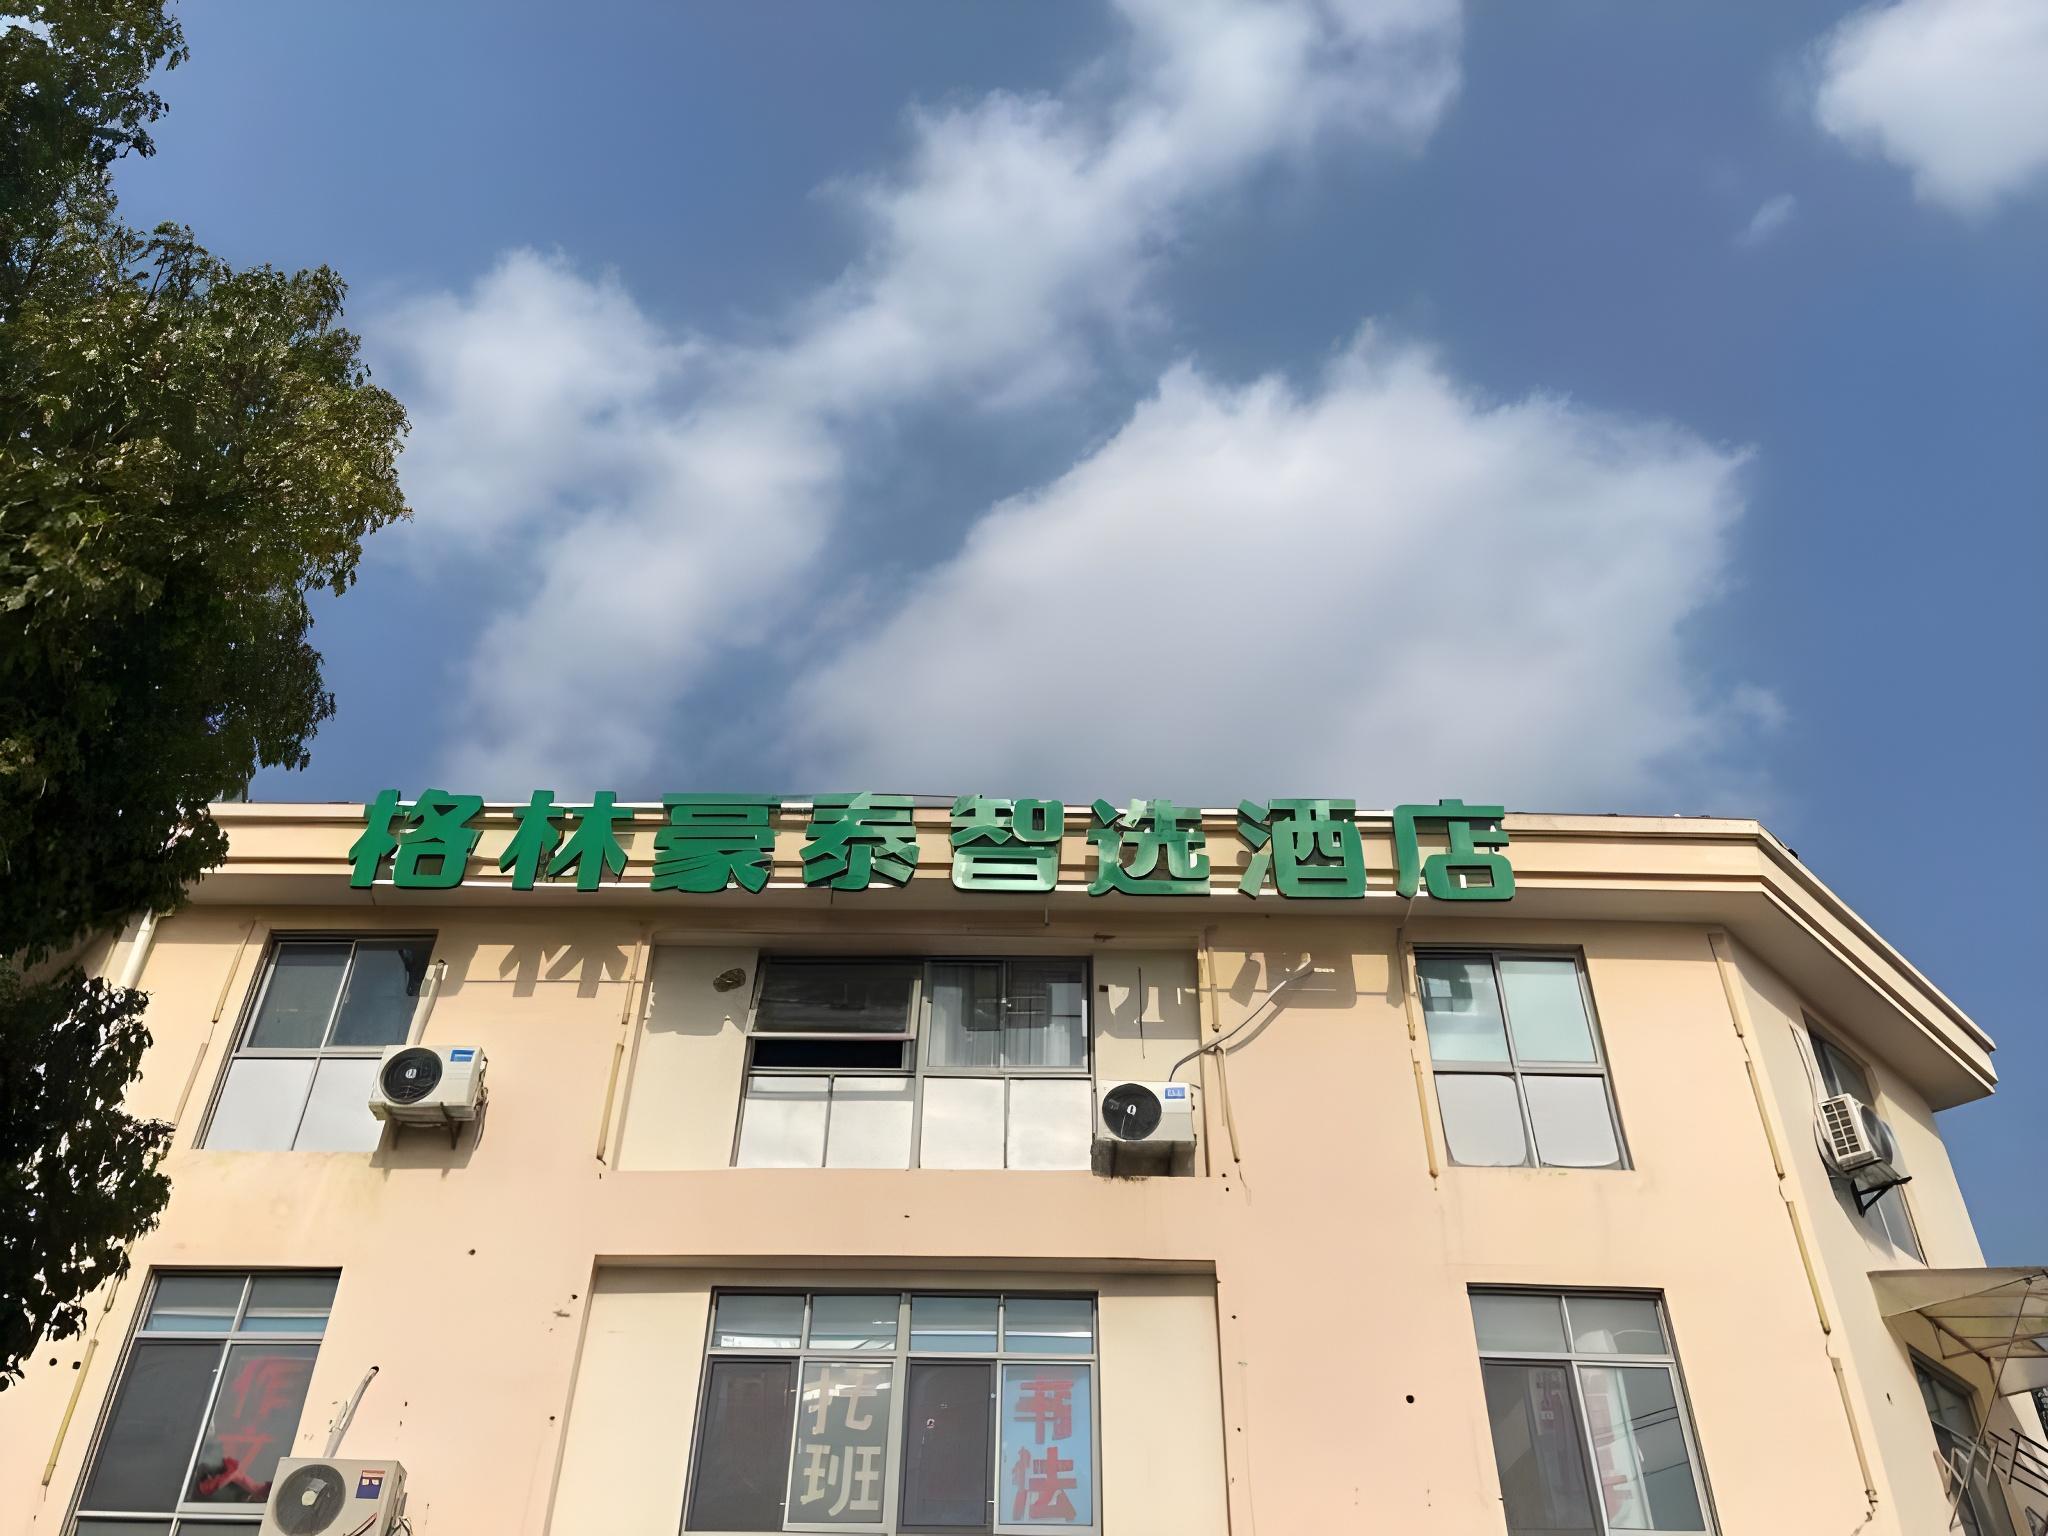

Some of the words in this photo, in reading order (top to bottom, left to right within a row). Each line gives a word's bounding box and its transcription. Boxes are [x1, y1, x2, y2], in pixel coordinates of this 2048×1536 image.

[348, 788, 1516, 902] 格林豪泰智选酒店
[801, 1367, 882, 1517] 托班
